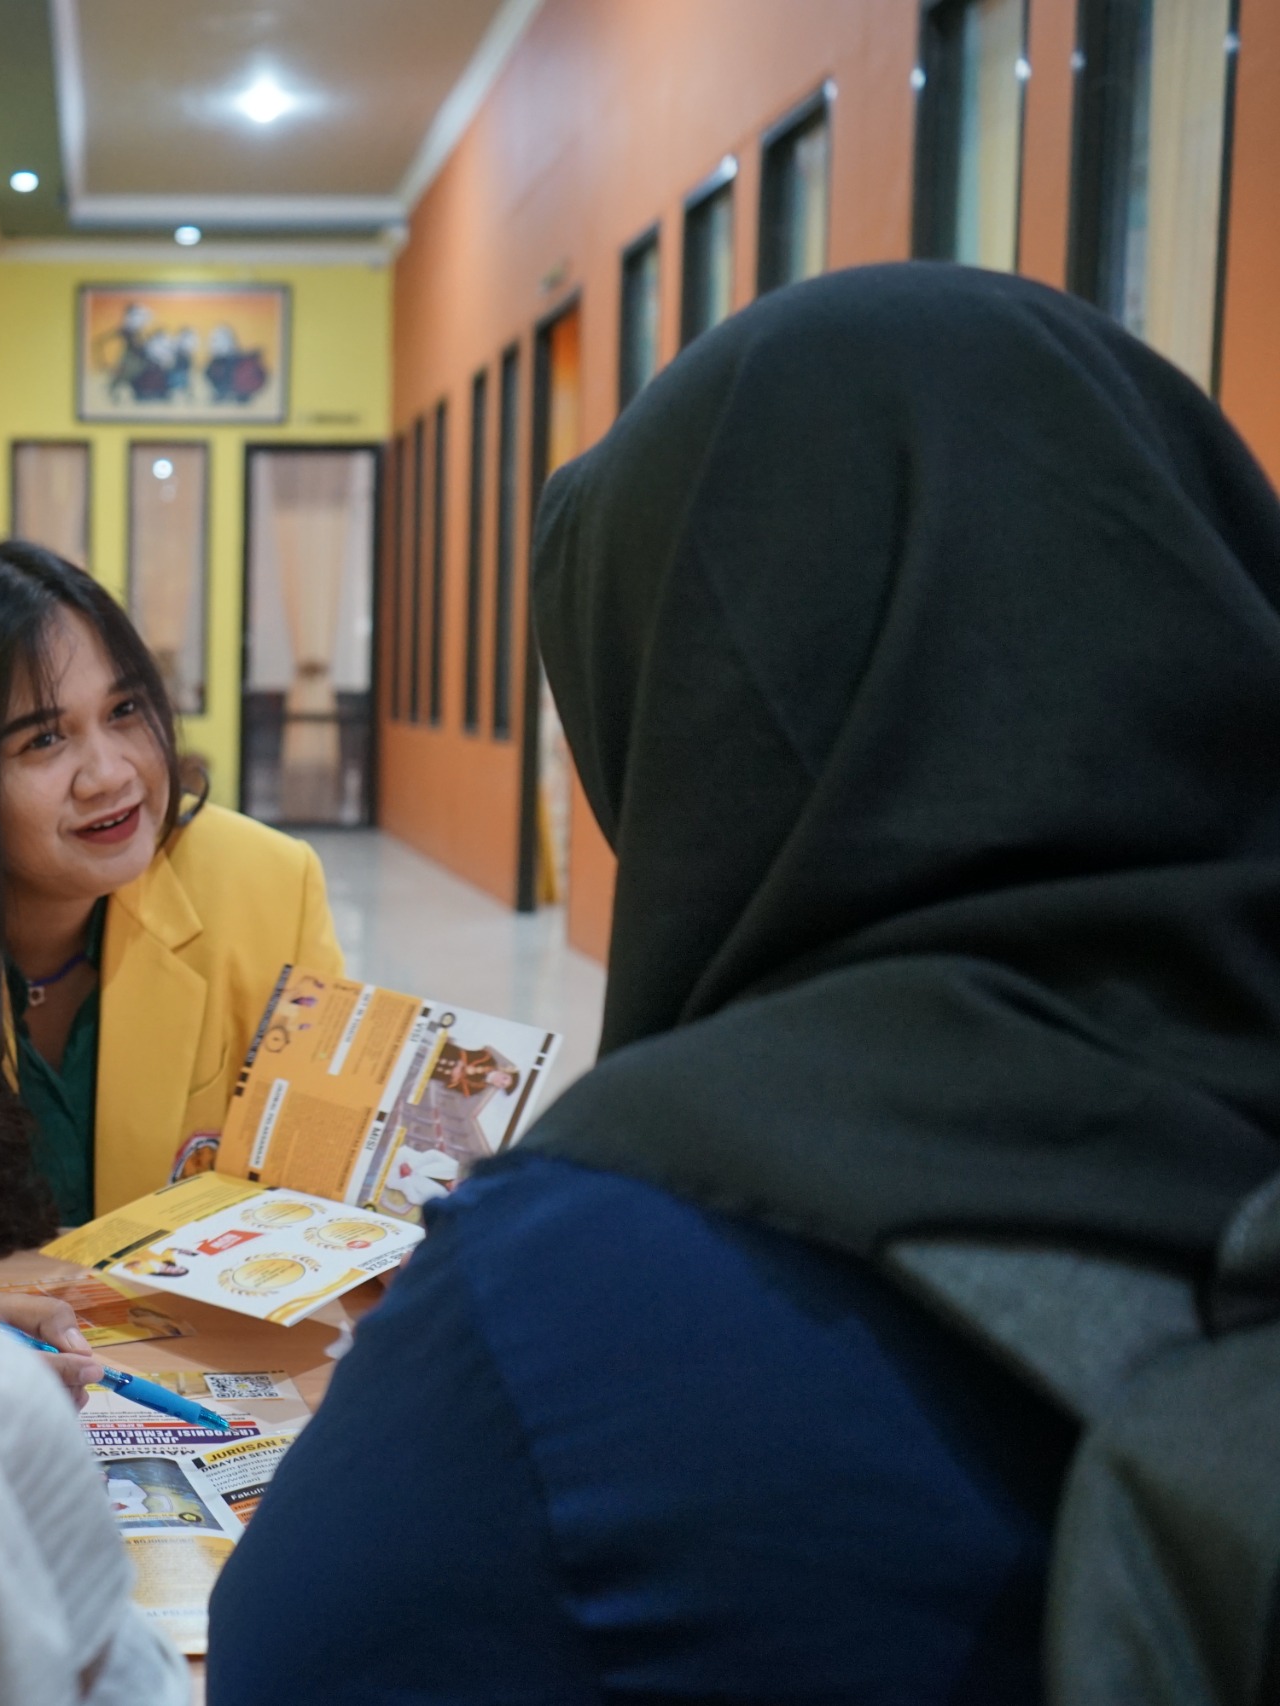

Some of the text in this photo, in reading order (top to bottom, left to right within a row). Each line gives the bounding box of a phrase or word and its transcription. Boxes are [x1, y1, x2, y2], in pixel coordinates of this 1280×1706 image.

[410, 1021, 426, 1043] VISI
[365, 1126, 382, 1151] MISI
[88, 1436, 180, 1445] JALUR PROGR
[210, 1440, 277, 1462] JURUSAN
[201, 1456, 246, 1473] DIBAYAR
[230, 1487, 267, 1501] Fakult
